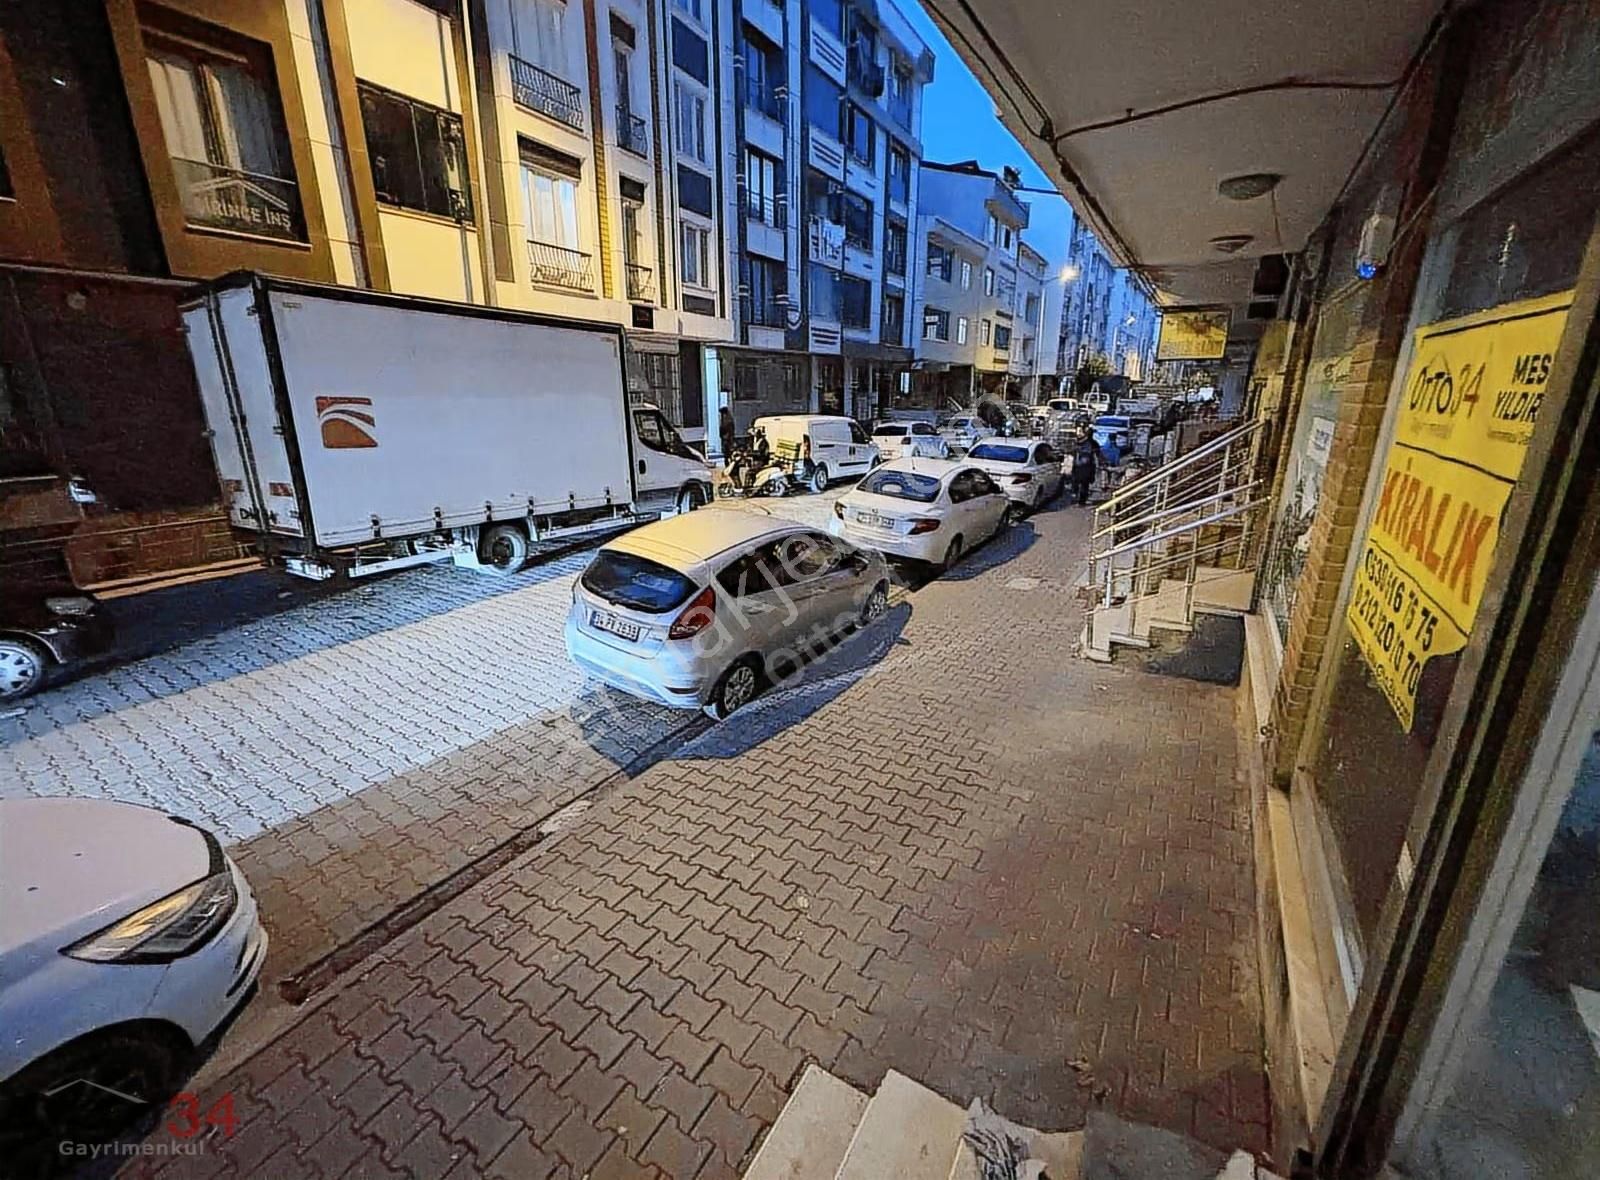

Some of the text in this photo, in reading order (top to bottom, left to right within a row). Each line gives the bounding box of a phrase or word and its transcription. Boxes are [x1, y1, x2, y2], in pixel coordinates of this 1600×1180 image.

[1512, 353, 1552, 385] MES
[1374, 457, 1495, 606] KİRALIK
[1415, 606, 1439, 652] 75
